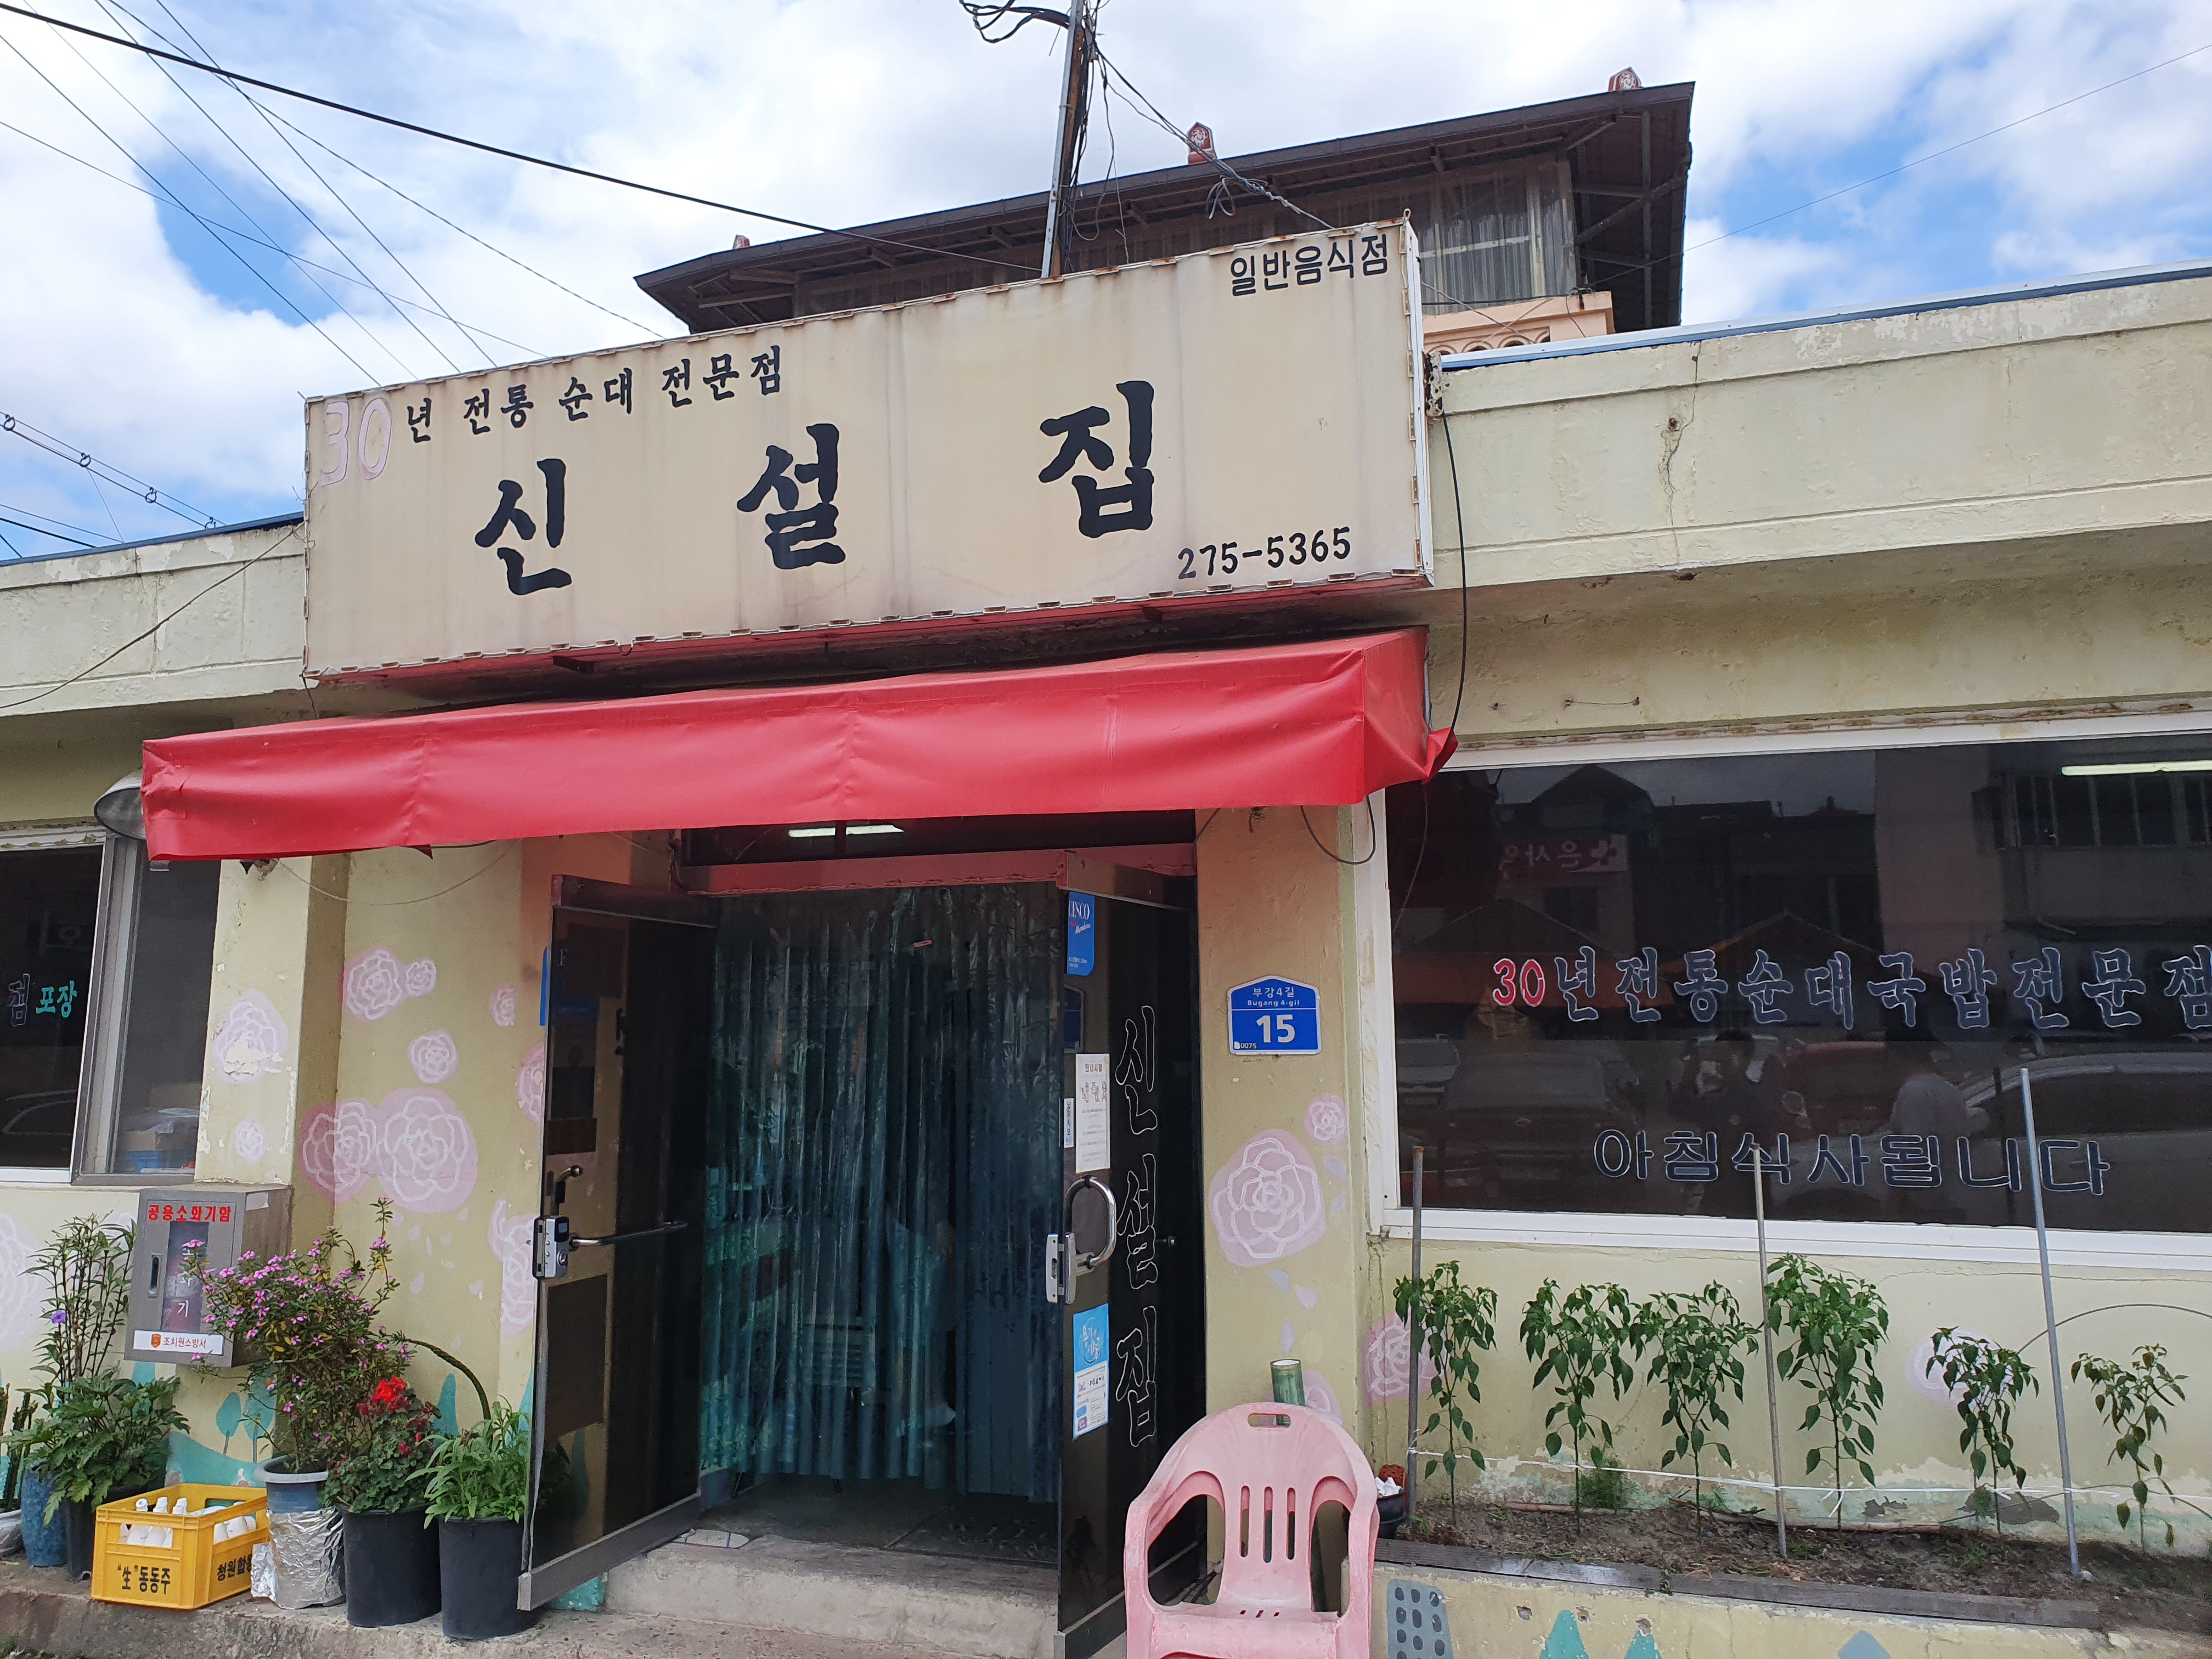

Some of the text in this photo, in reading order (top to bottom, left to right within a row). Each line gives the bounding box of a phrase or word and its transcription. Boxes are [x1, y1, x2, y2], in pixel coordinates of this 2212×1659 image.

[1230, 233, 1389, 297] 일반음식점
[462, 383, 534, 435] 전통
[558, 368, 634, 421] 순대
[662, 346, 781, 408] 전문점
[1177, 526, 1351, 580] 275-5365
[1068, 901, 1090, 920] CESCO
[36, 980, 77, 1018] 포장
[1252, 987, 1295, 998] 부강4길
[1256, 1014, 1295, 1043] 15
[148, 1205, 232, 1222] 공용소화기함
[163, 1336, 206, 1348] 조치원소방서
